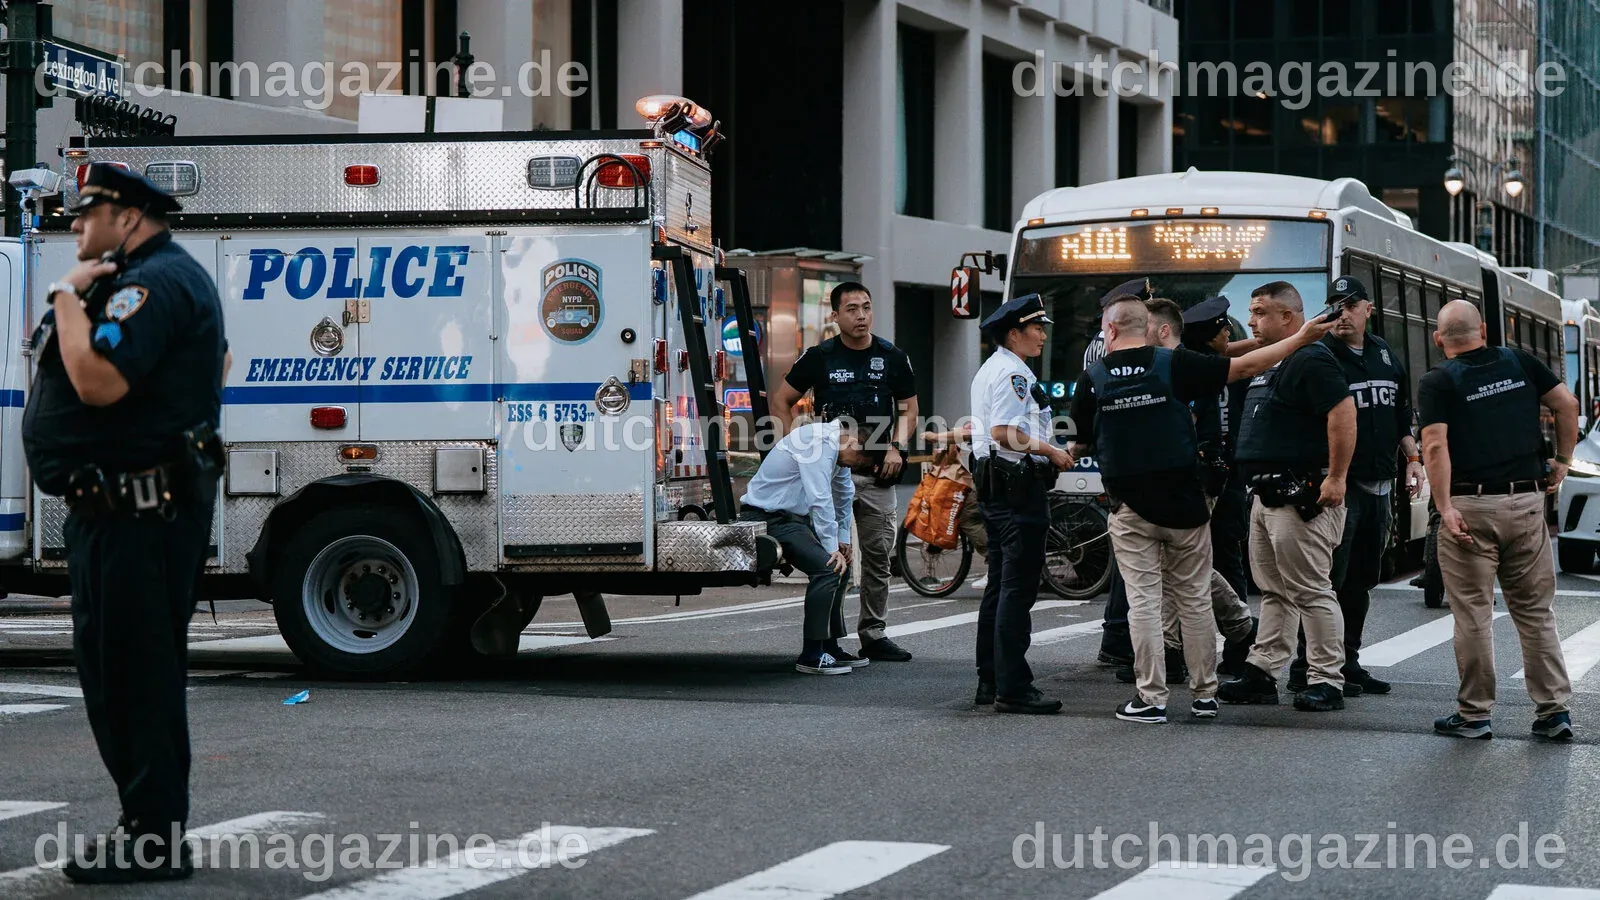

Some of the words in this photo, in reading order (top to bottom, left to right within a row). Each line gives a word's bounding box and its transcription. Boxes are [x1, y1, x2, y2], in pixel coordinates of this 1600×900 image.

[41, 51, 97, 88] Lexington
[98, 69, 119, 93] Ave
[243, 245, 470, 300] POLICE
[545, 263, 598, 287] POLICE
[245, 356, 376, 382] EMERGENCY
[380, 356, 472, 381] SERVICE
[1466, 380, 1526, 402] COUNTERTERRORISM
[1478, 379, 1513, 392] NYPD
[727, 391, 752, 409] OPE
[1102, 396, 1167, 411] COUNTERTERRORISM
[1114, 394, 1152, 404] NYPD
[1356, 387, 1396, 408] LICE
[507, 403, 533, 422] ESS
[538, 403, 547, 421] 6
[554, 403, 588, 422] 5753
